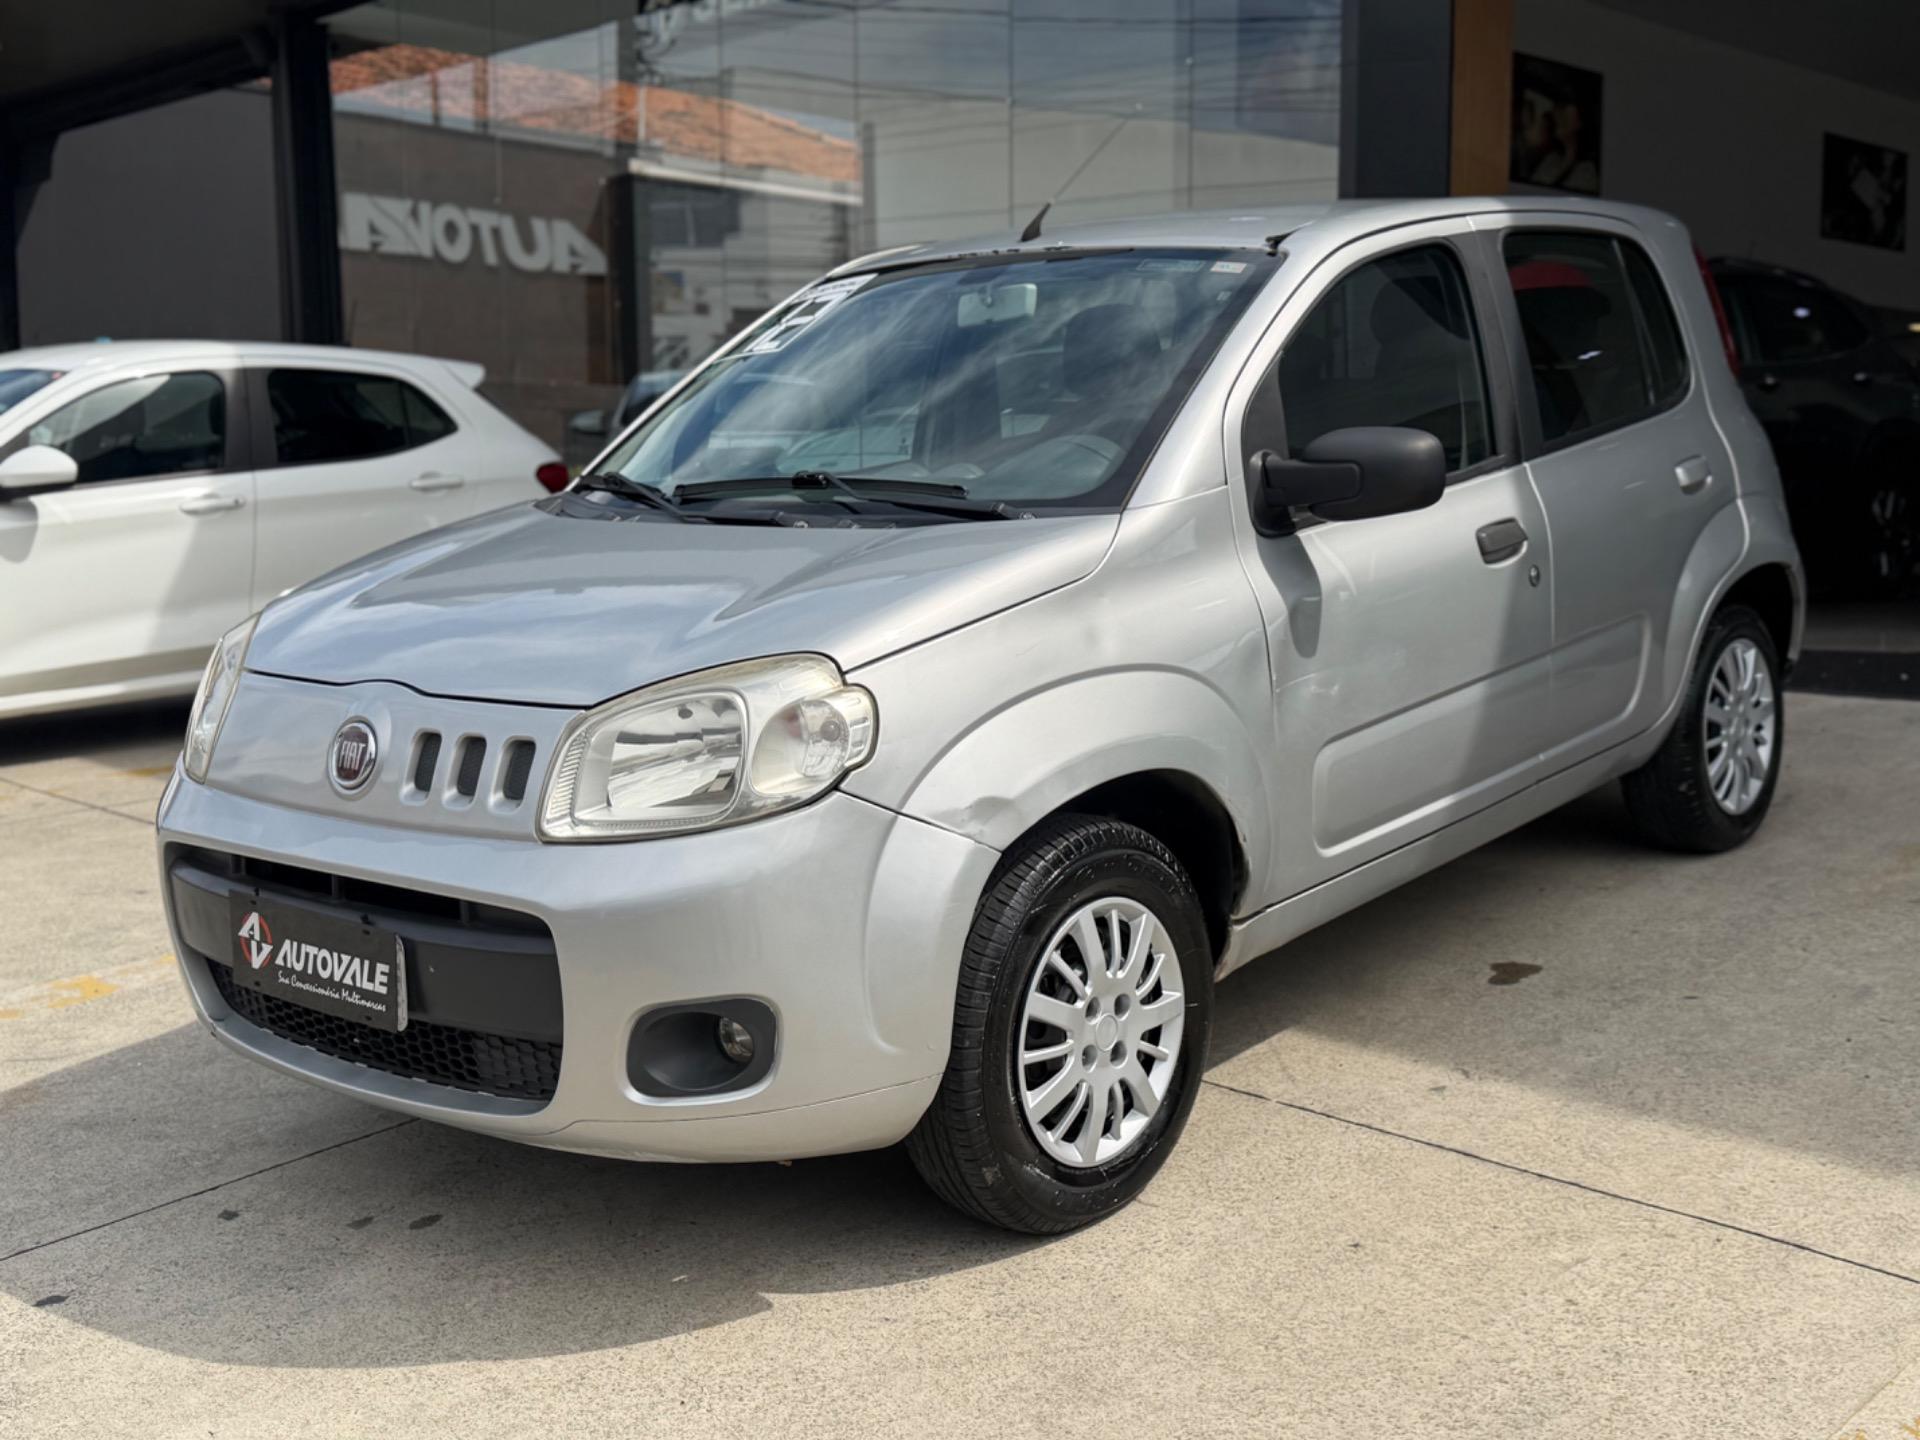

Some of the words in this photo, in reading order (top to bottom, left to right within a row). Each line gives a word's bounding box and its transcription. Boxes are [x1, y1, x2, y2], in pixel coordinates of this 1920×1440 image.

[338, 740, 367, 770] FIAT
[274, 938, 390, 995] AUTOVALE
[341, 988, 387, 1012] Multimarcas
